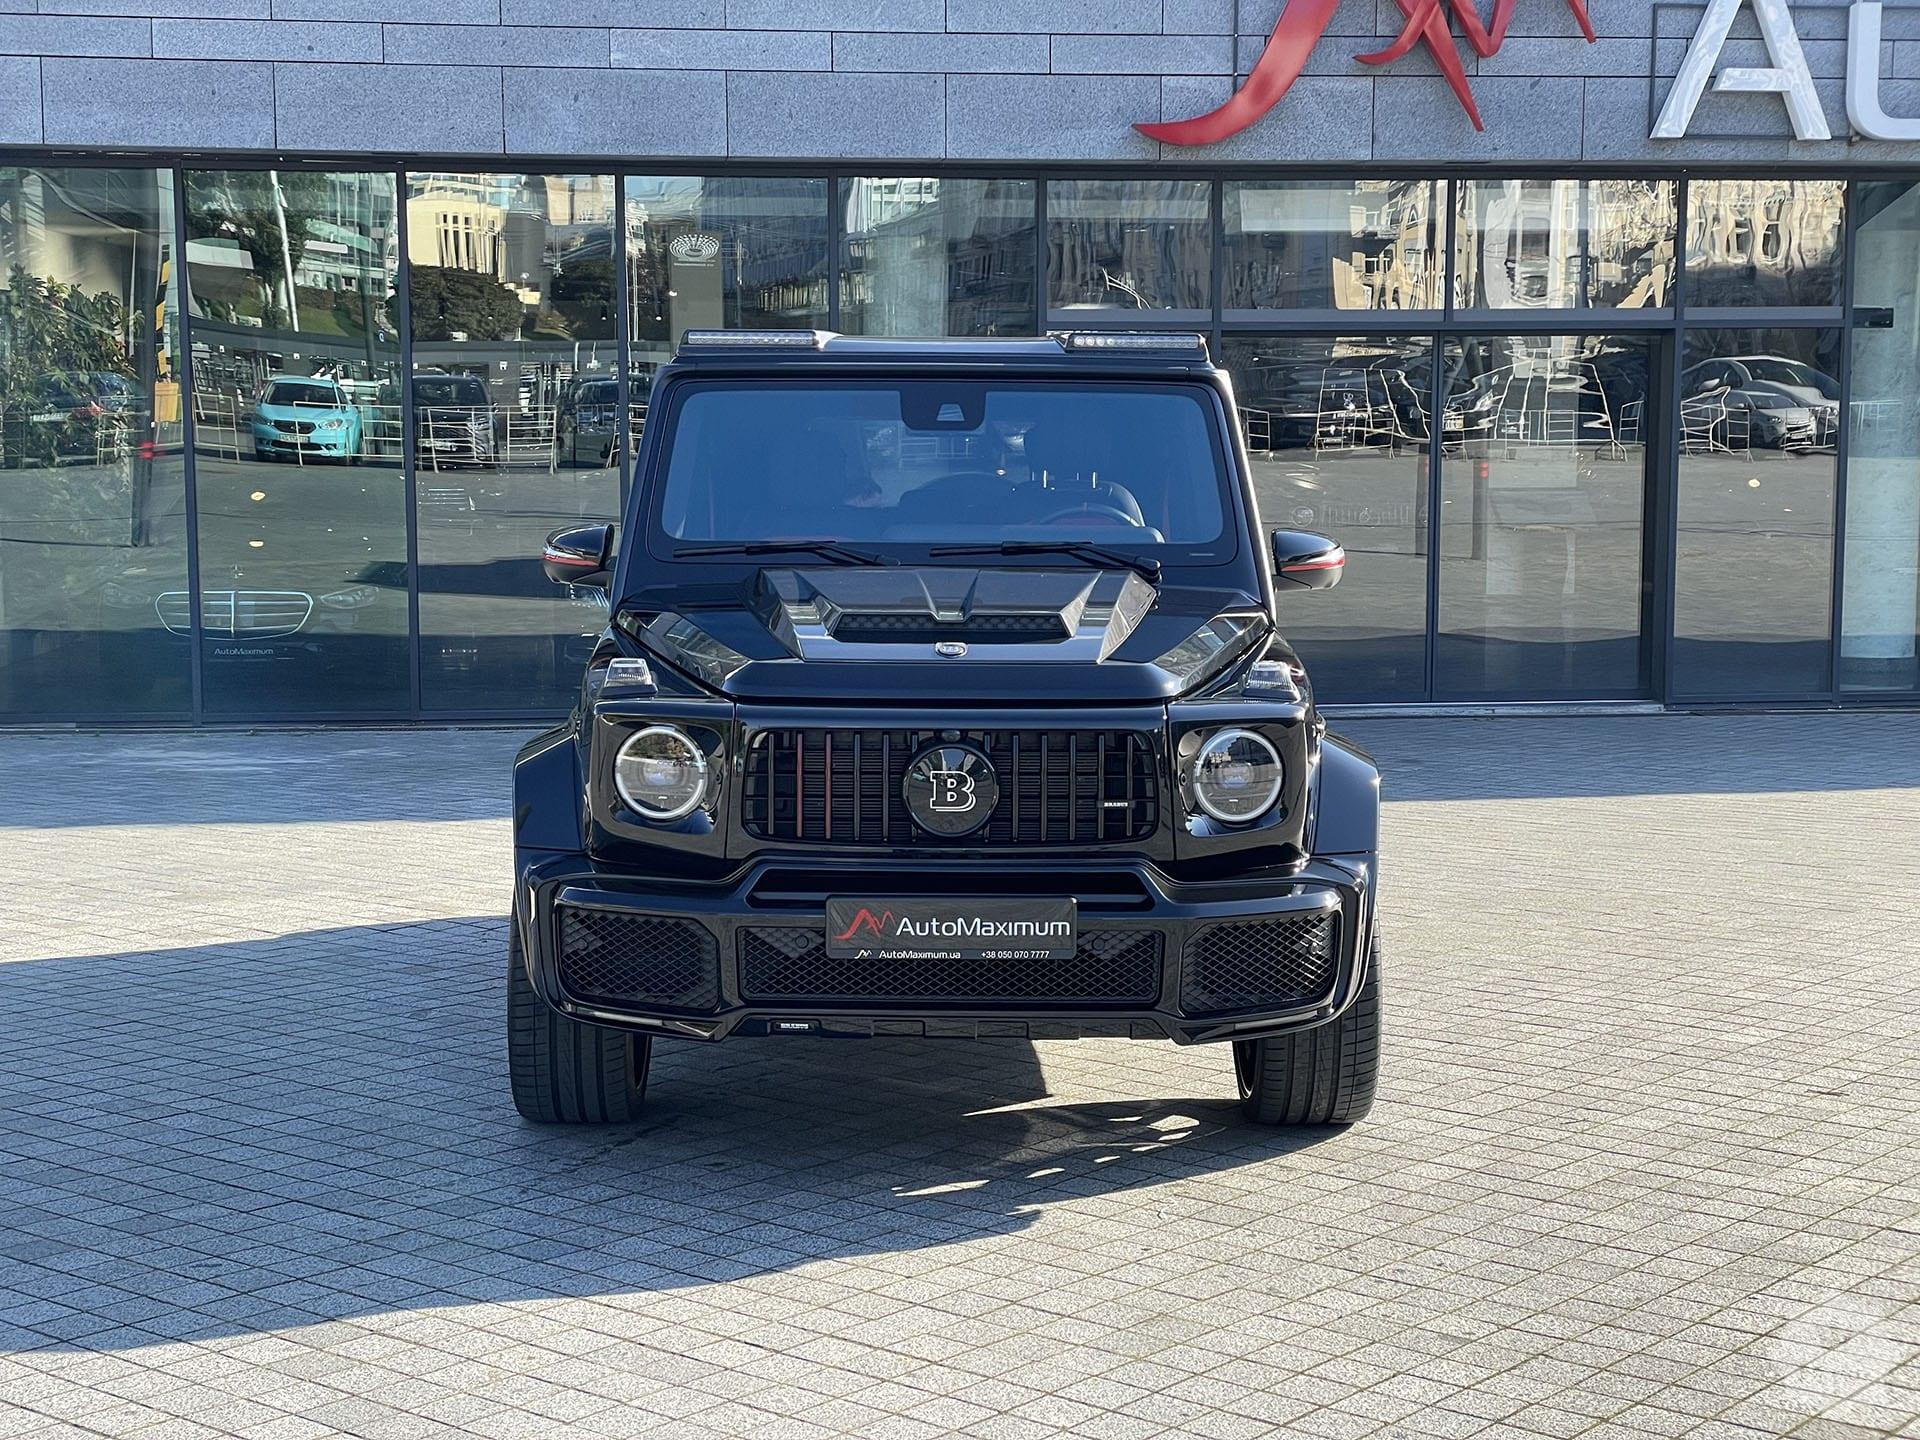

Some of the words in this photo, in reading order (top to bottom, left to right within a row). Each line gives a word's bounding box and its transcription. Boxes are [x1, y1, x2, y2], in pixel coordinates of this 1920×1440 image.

[929, 770, 976, 812] B
[896, 917, 1071, 936] AutoMaximum
[879, 950, 961, 959] AutoMaximum.ua
[981, 950, 996, 959] +38
[997, 950, 1012, 959] 050
[1014, 950, 1029, 959] 070
[1030, 950, 1050, 959] 7777
